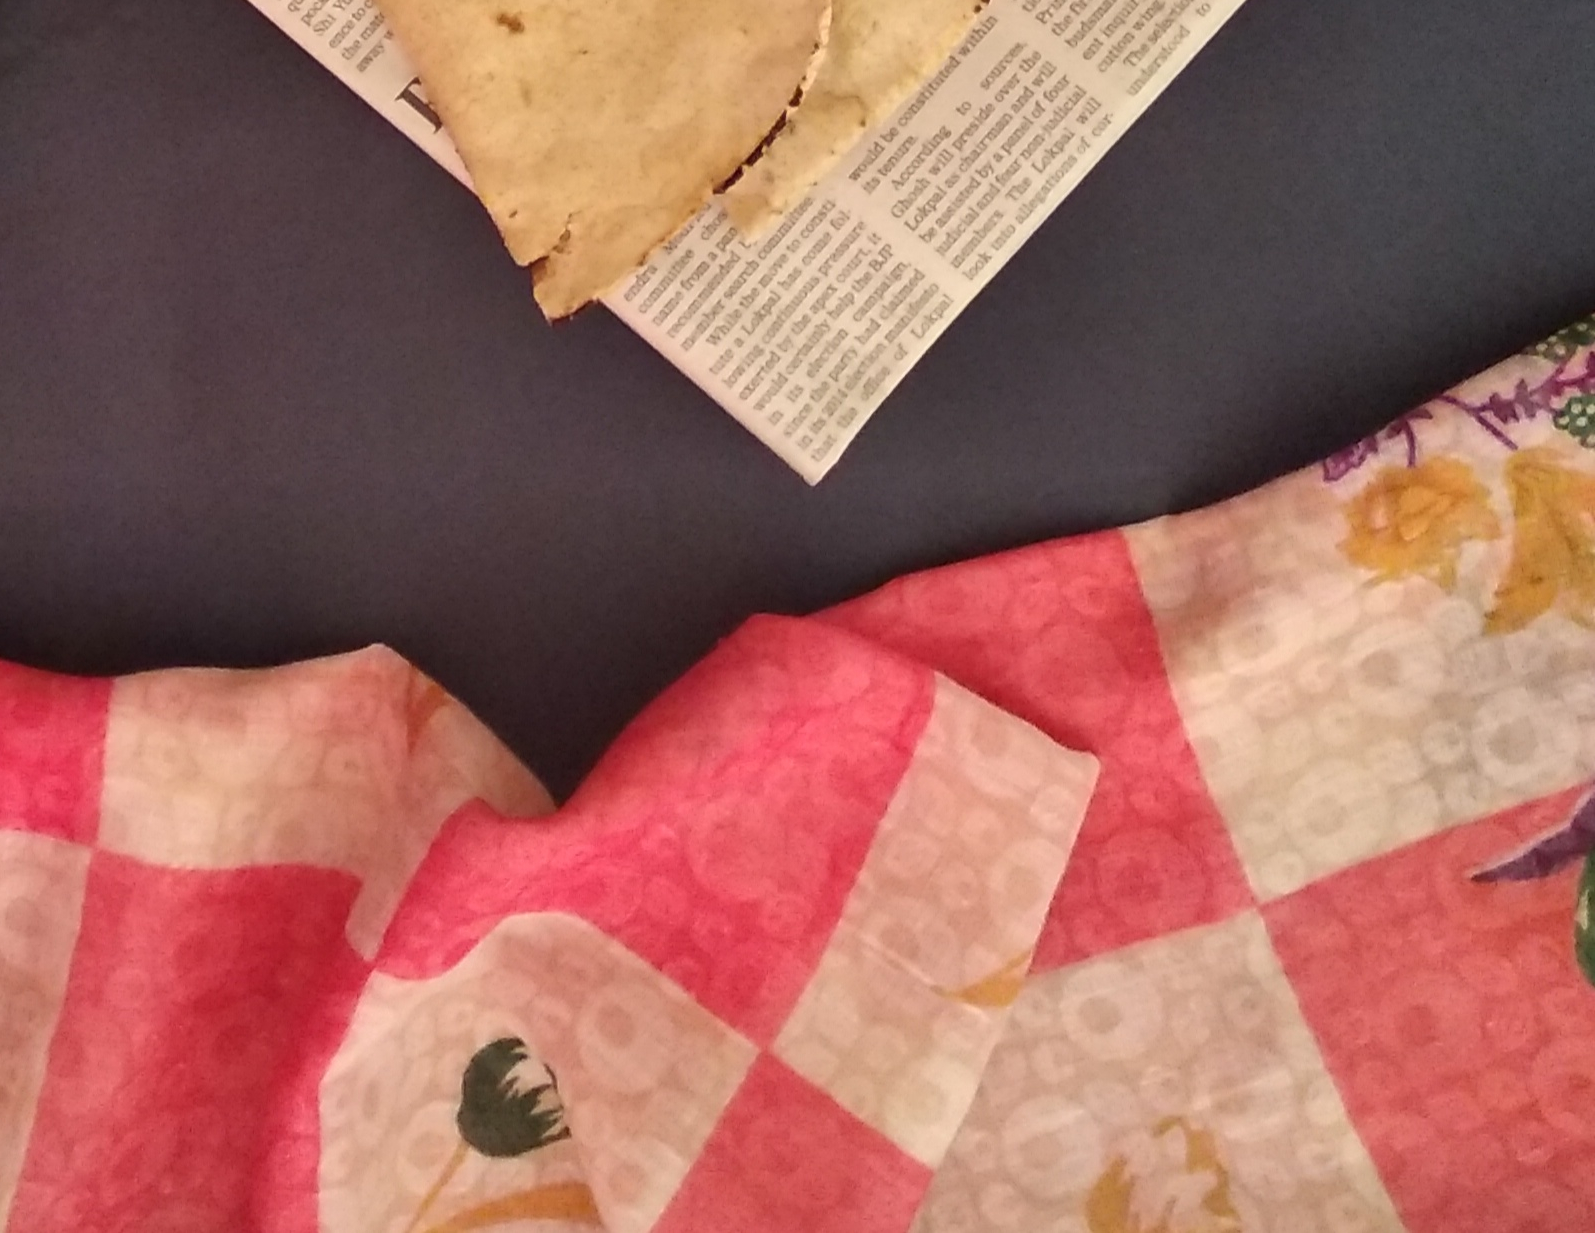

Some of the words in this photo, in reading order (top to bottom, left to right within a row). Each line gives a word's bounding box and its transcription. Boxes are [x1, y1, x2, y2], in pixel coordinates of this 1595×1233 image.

[1051, 14, 1073, 36] the
[1082, 38, 1103, 60] ent
[1097, 31, 1135, 72] cution
[1122, 42, 1149, 67] The
[1195, 2, 1211, 17] to
[848, 141, 885, 181] would
[880, 126, 899, 143] be
[897, 55, 960, 126] constituted
[957, 15, 997, 56] within
[890, 177, 930, 218] Ghosh
[928, 148, 954, 176] will
[951, 102, 995, 152] preside
[994, 72, 1020, 102] over
[1018, 50, 1041, 73] the
[891, 125, 951, 191] According
[955, 101, 971, 116] to
[904, 185, 947, 231] Lokpal
[944, 172, 960, 188] as
[958, 112, 1013, 172] chairman
[1009, 85, 1034, 113] and
[1031, 60, 1056, 87] will
[918, 226, 937, 243] be
[934, 176, 980, 228] assisted
[975, 161, 995, 179] by
[1000, 115, 1033, 155] panel
[1030, 101, 1045, 118] of
[1042, 73, 1069, 102] four
[1006, 176, 1031, 200] The
[1031, 127, 1075, 174] Lokpal
[1075, 97, 1101, 124] will
[935, 206, 980, 256] judicial
[975, 182, 1000, 210] and
[995, 158, 1022, 186] four
[962, 251, 992, 280] look
[990, 223, 1016, 251] into
[1014, 154, 1077, 224] allegations
[1075, 136, 1090, 154] of
